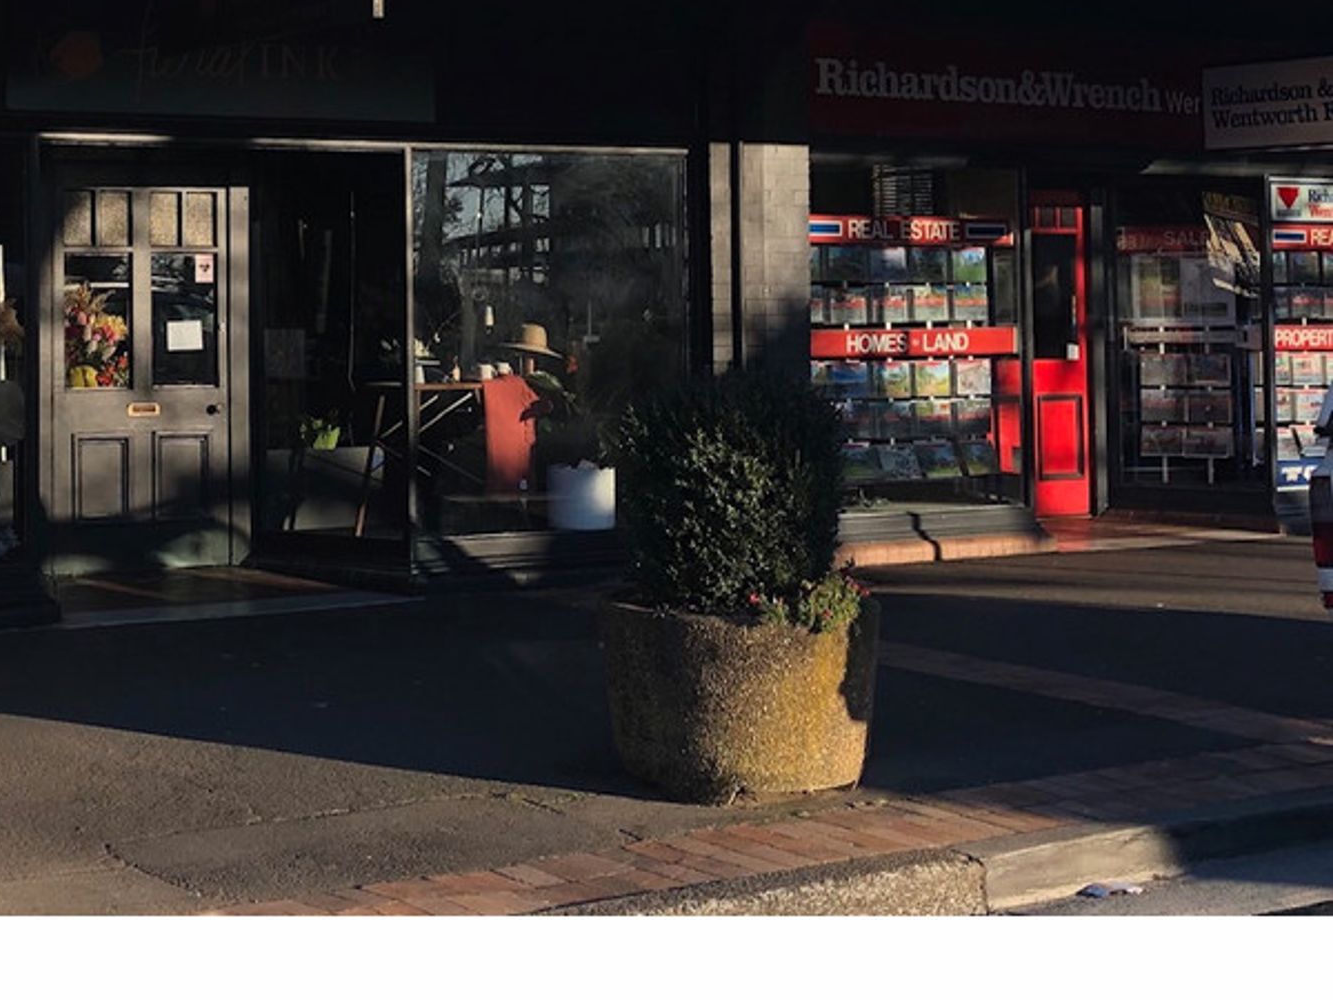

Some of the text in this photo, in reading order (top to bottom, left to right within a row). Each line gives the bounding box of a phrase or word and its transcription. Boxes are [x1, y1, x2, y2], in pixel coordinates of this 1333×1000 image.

[1211, 81, 1313, 107] Richardson
[1212, 102, 1318, 129] Wentworth
[848, 219, 961, 240] REAL ESTATE
[846, 332, 969, 352] HOMES LAND
